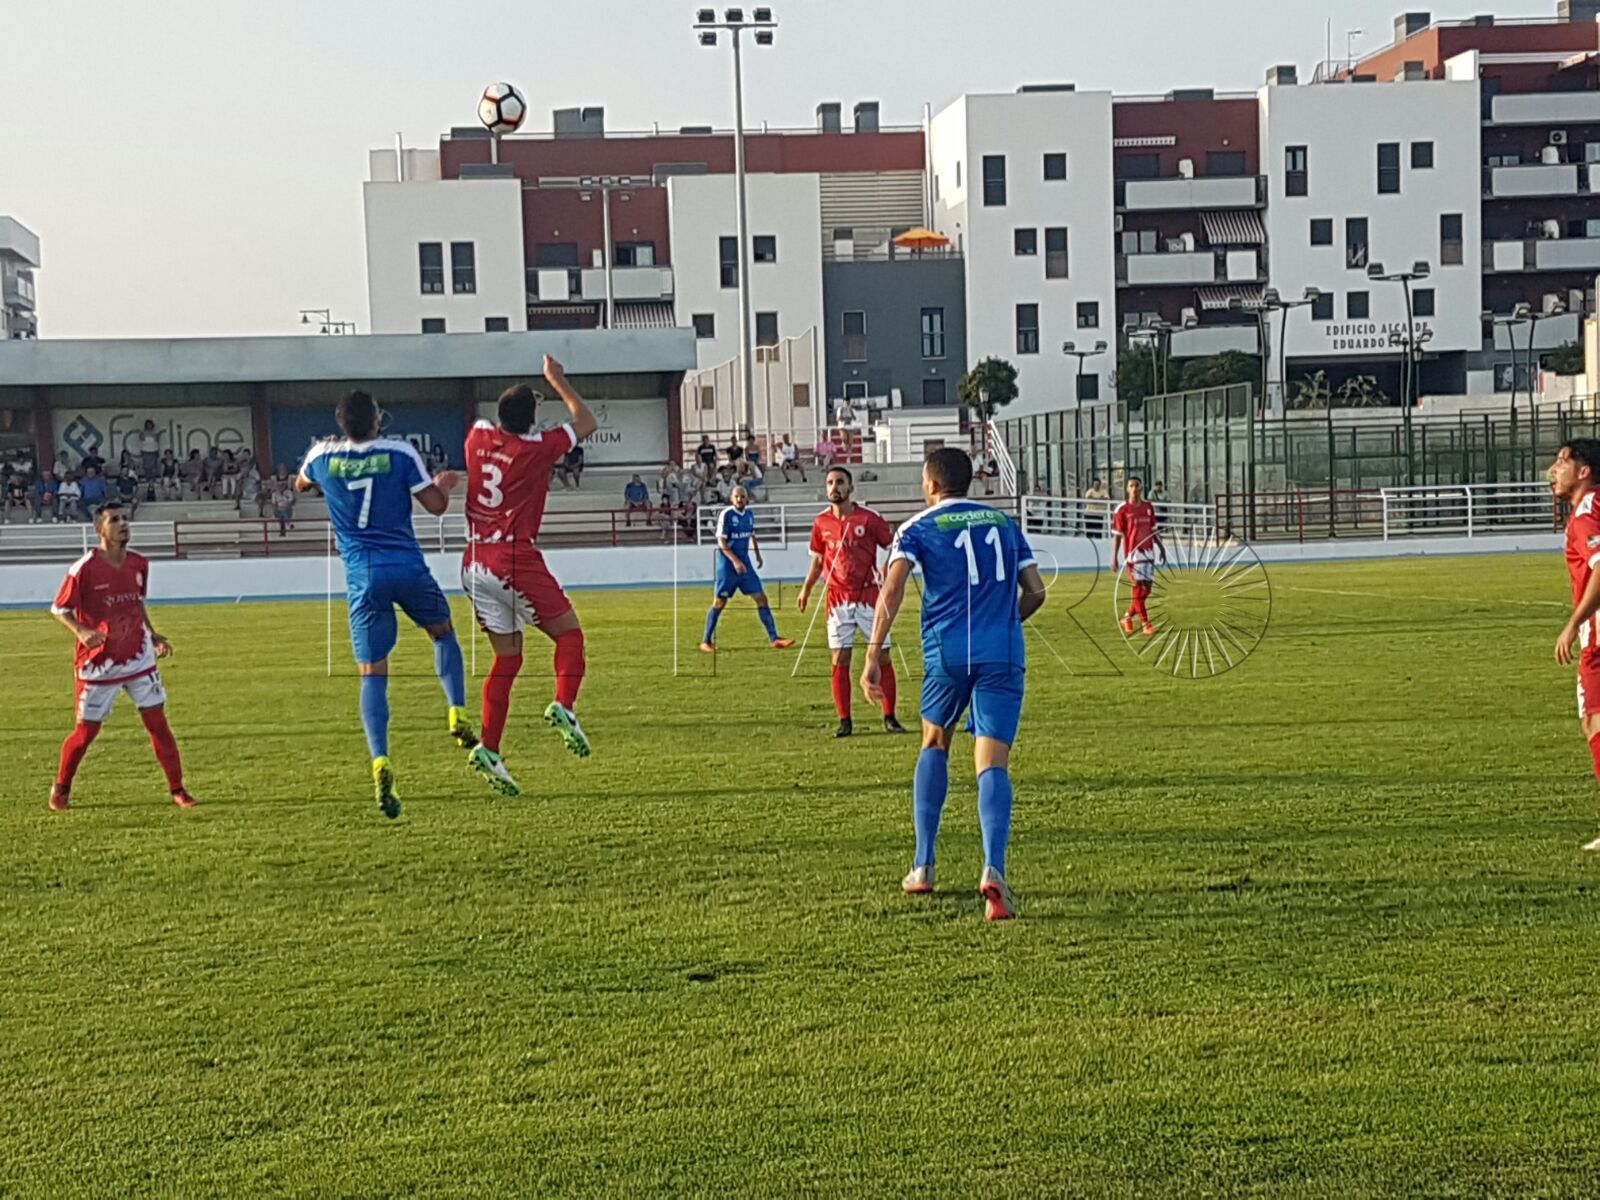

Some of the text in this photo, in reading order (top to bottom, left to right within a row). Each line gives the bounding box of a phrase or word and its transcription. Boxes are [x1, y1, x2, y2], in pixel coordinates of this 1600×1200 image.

[1326, 322, 1428, 336] EDIFICIO ALCADE
[1333, 338, 1385, 349] EDUARDO
[348, 478, 374, 529] 7
[477, 463, 504, 508] 3
[954, 526, 1005, 586] 11
